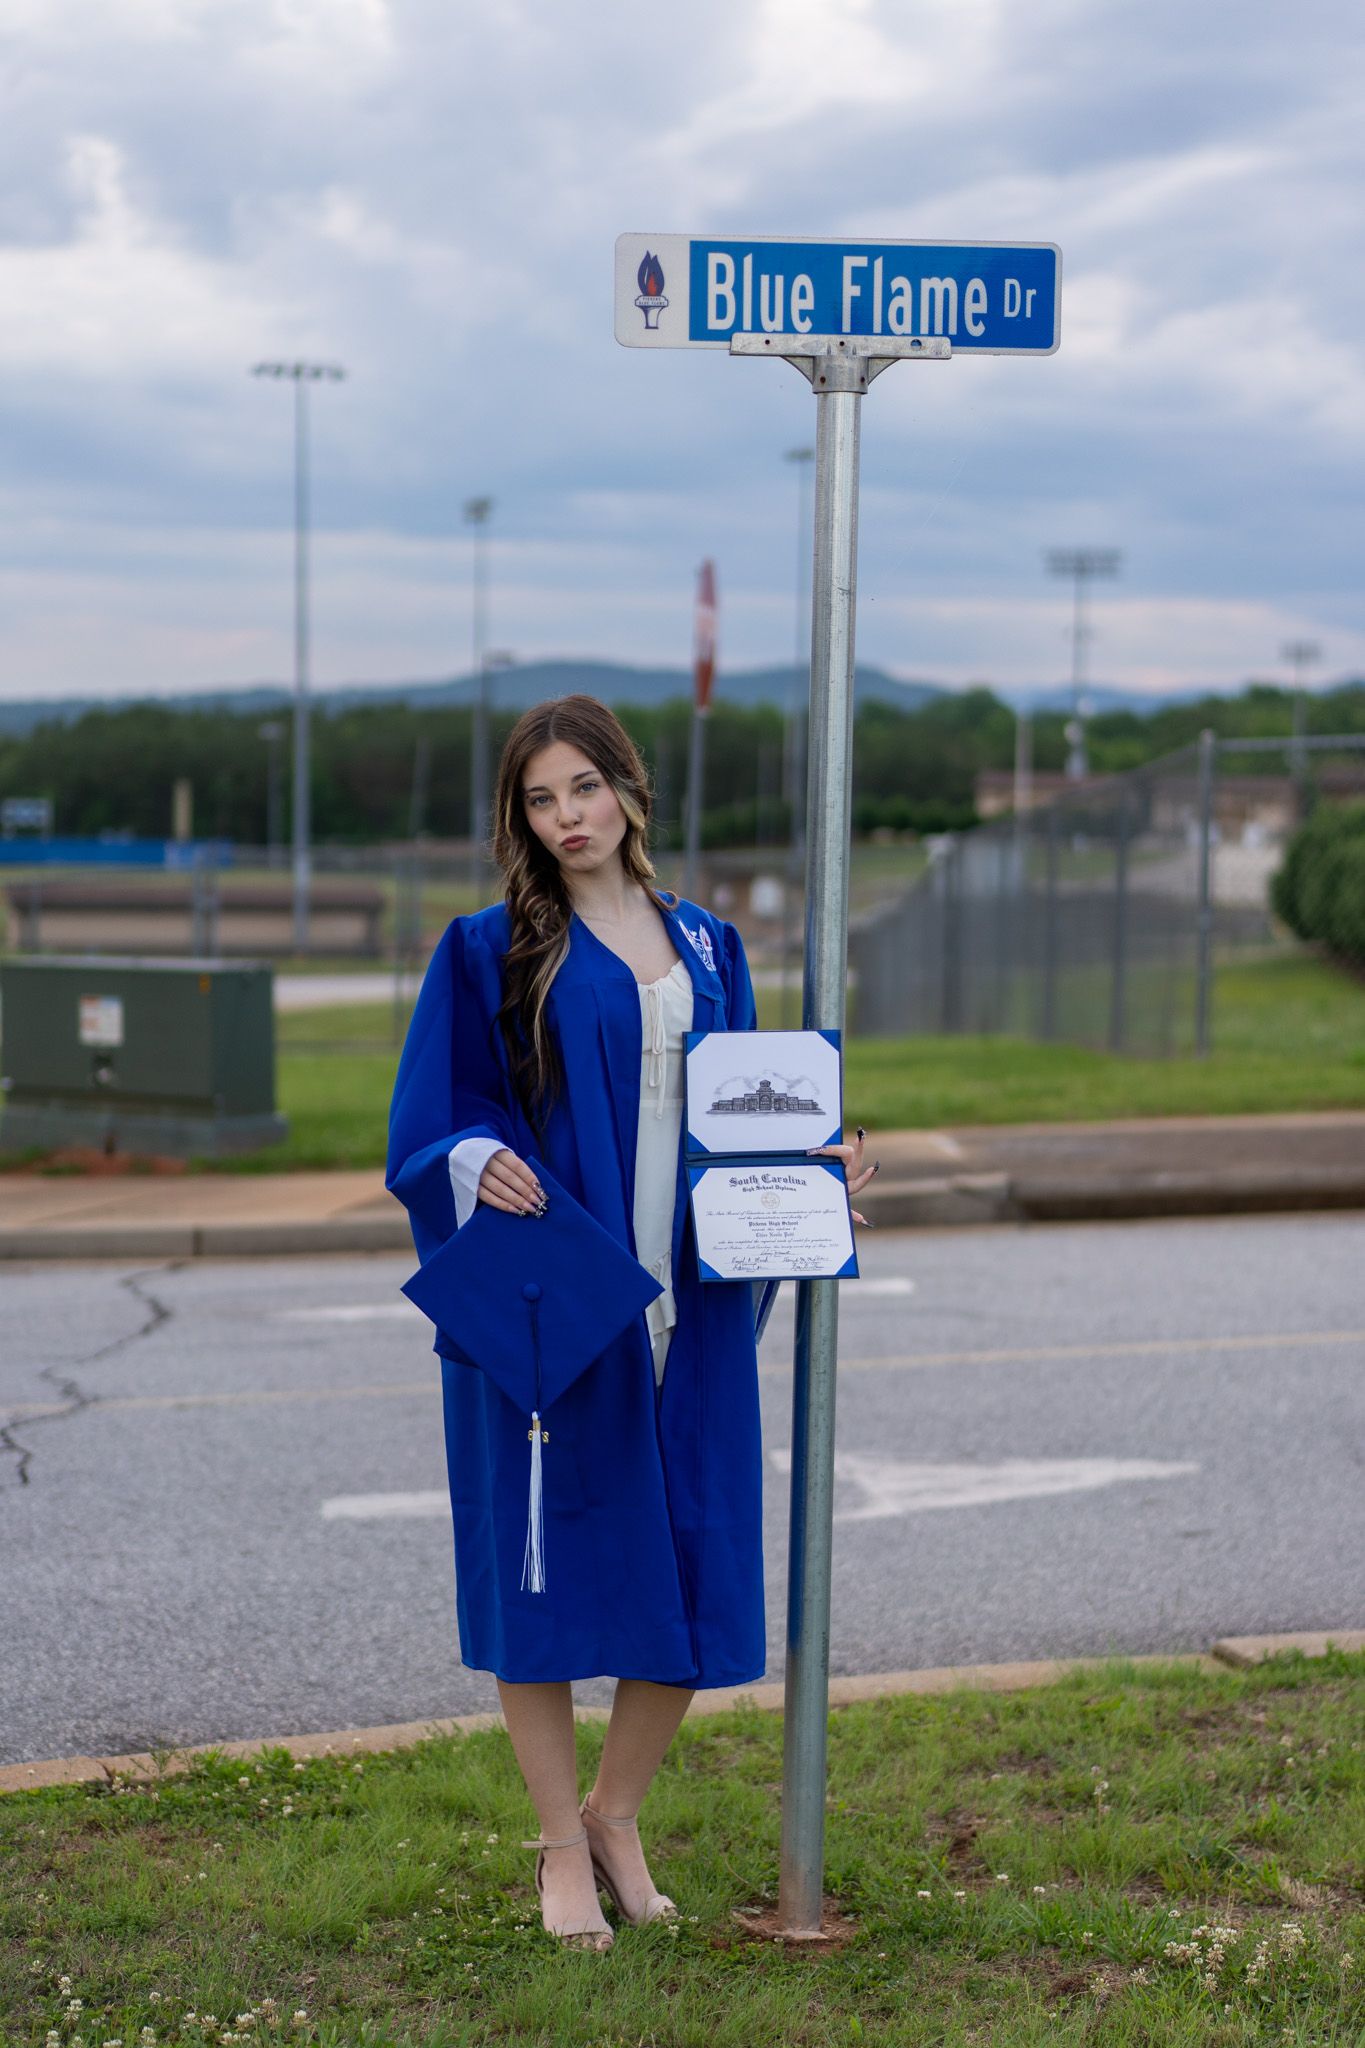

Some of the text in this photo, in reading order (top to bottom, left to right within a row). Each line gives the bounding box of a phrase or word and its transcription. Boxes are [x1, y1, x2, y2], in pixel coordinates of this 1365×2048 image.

[707, 251, 1037, 337] Blue Flame Dr
[729, 1173, 807, 1188] South Carolina
